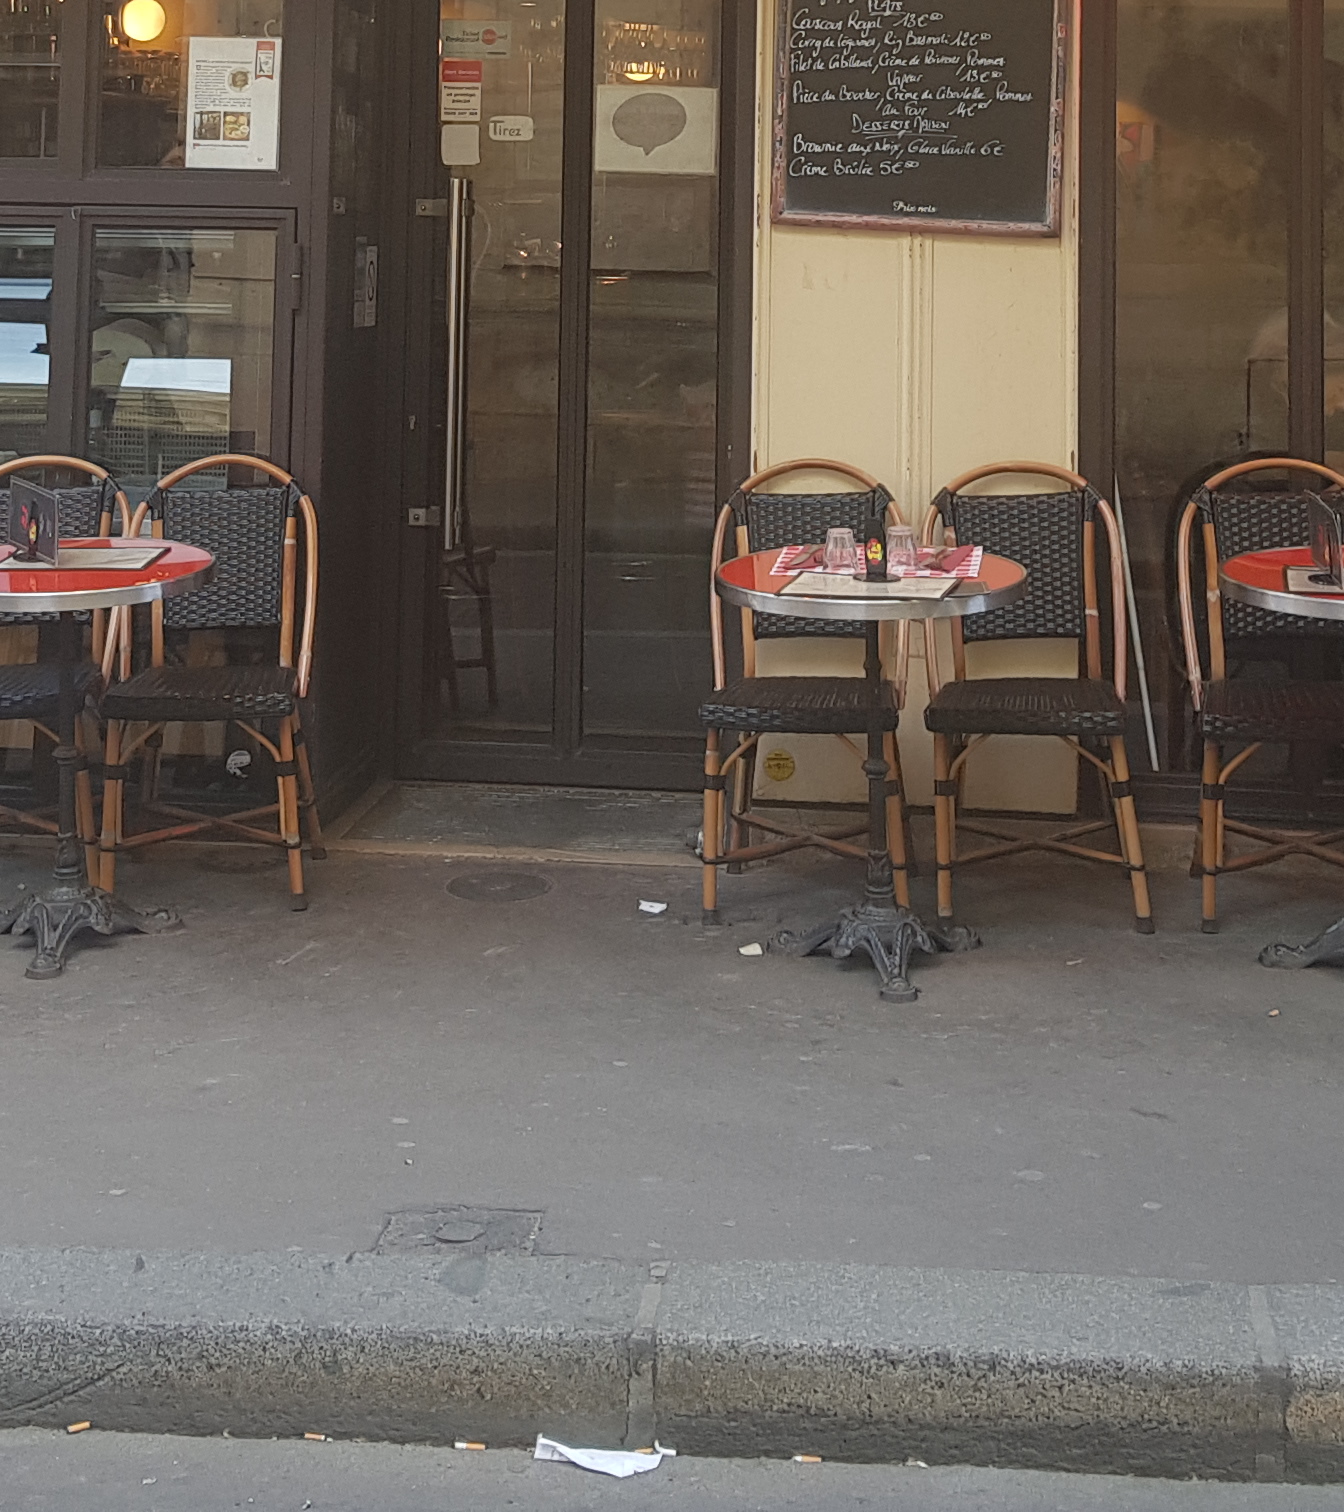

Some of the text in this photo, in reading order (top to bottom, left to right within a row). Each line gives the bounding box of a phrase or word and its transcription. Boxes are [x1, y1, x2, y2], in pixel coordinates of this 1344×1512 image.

[792, 8, 844, 30] Couscous
[847, 9, 883, 38] Royal
[790, 53, 813, 73] Filet
[489, 120, 522, 136] Tirez
[793, 134, 844, 154] Brownie
[980, 140, 1006, 156] 6€
